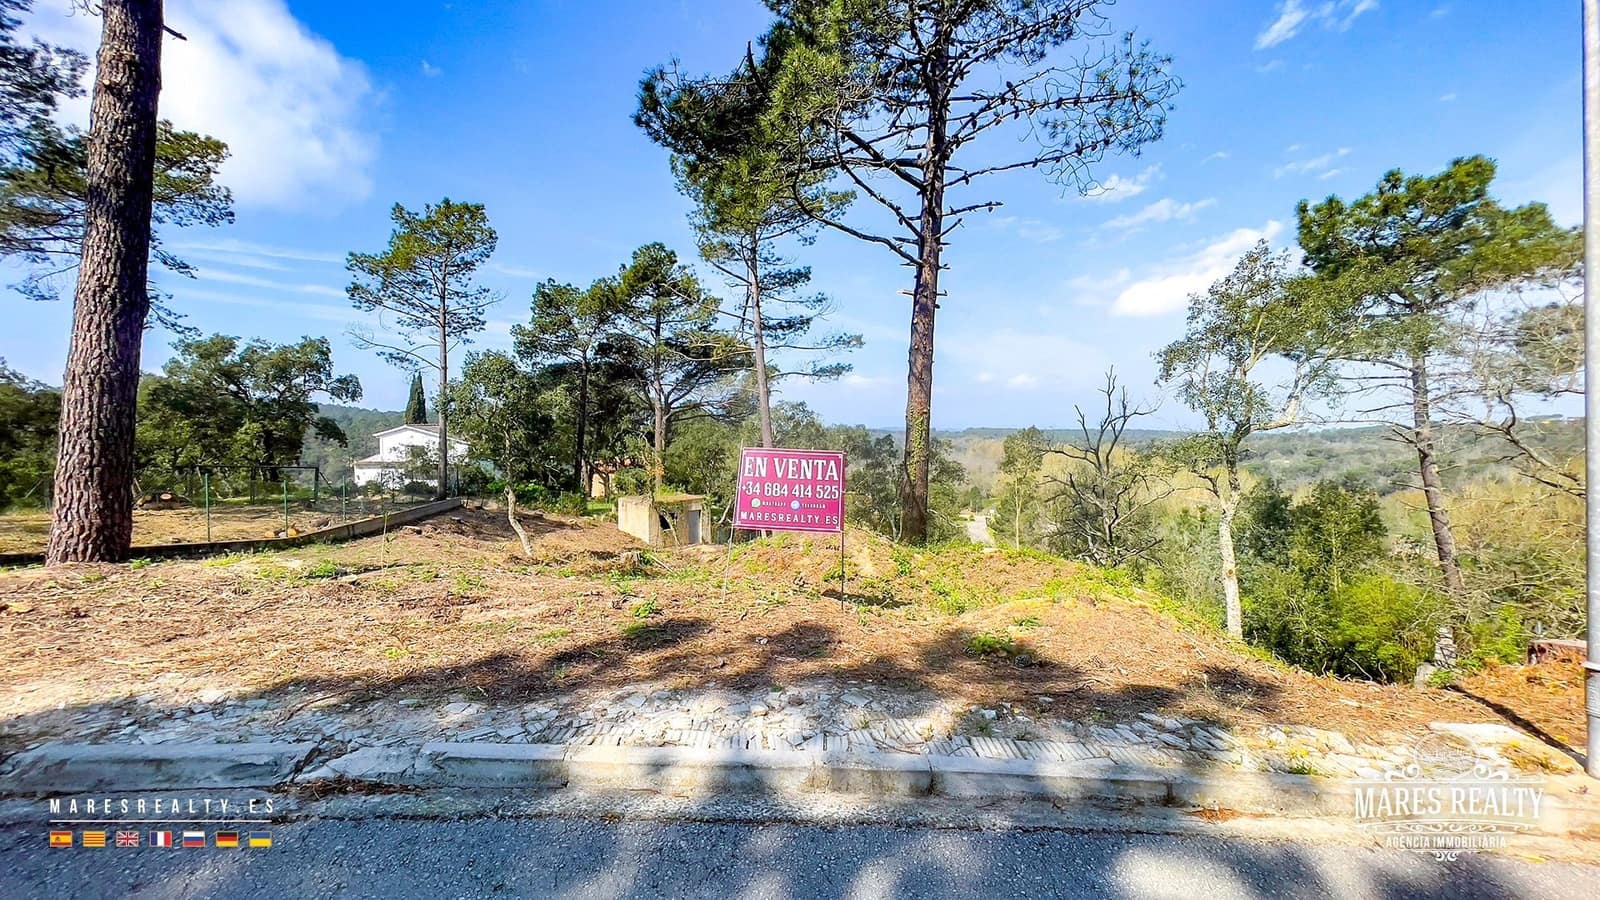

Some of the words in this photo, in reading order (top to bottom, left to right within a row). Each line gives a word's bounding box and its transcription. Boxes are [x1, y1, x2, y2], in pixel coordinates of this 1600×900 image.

[744, 456, 768, 478] EN
[773, 457, 839, 481] VENTA
[742, 481, 761, 496] +34
[764, 482, 788, 497] 684
[792, 483, 812, 498] 414
[816, 485, 839, 499] 525
